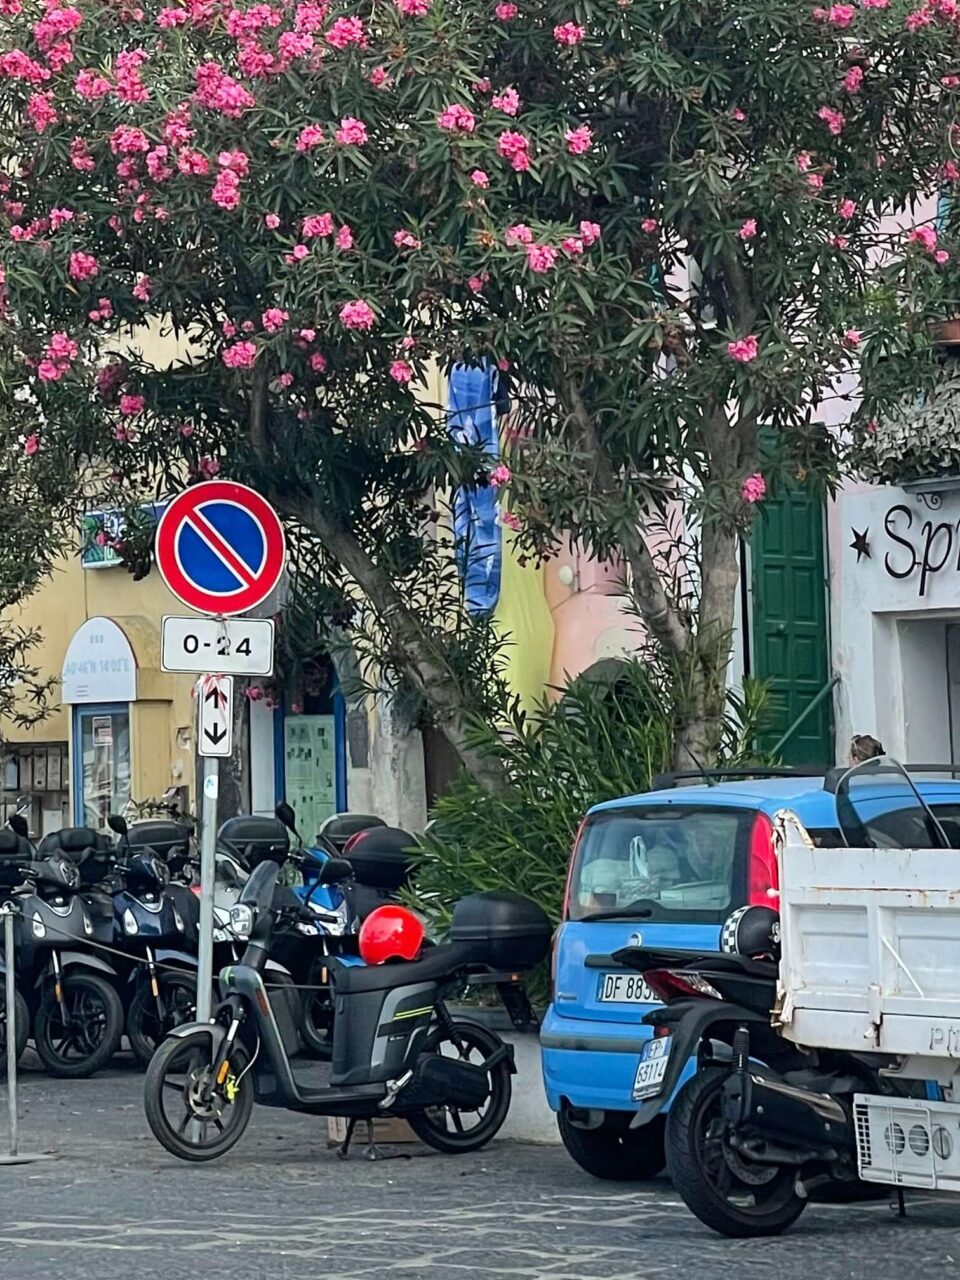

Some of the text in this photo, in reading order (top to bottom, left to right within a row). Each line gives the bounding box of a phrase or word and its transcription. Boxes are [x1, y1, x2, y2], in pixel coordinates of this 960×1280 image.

[884, 504, 960, 596] Sp
[183, 634, 252, 657] 0-24
[605, 976, 623, 999] DF
